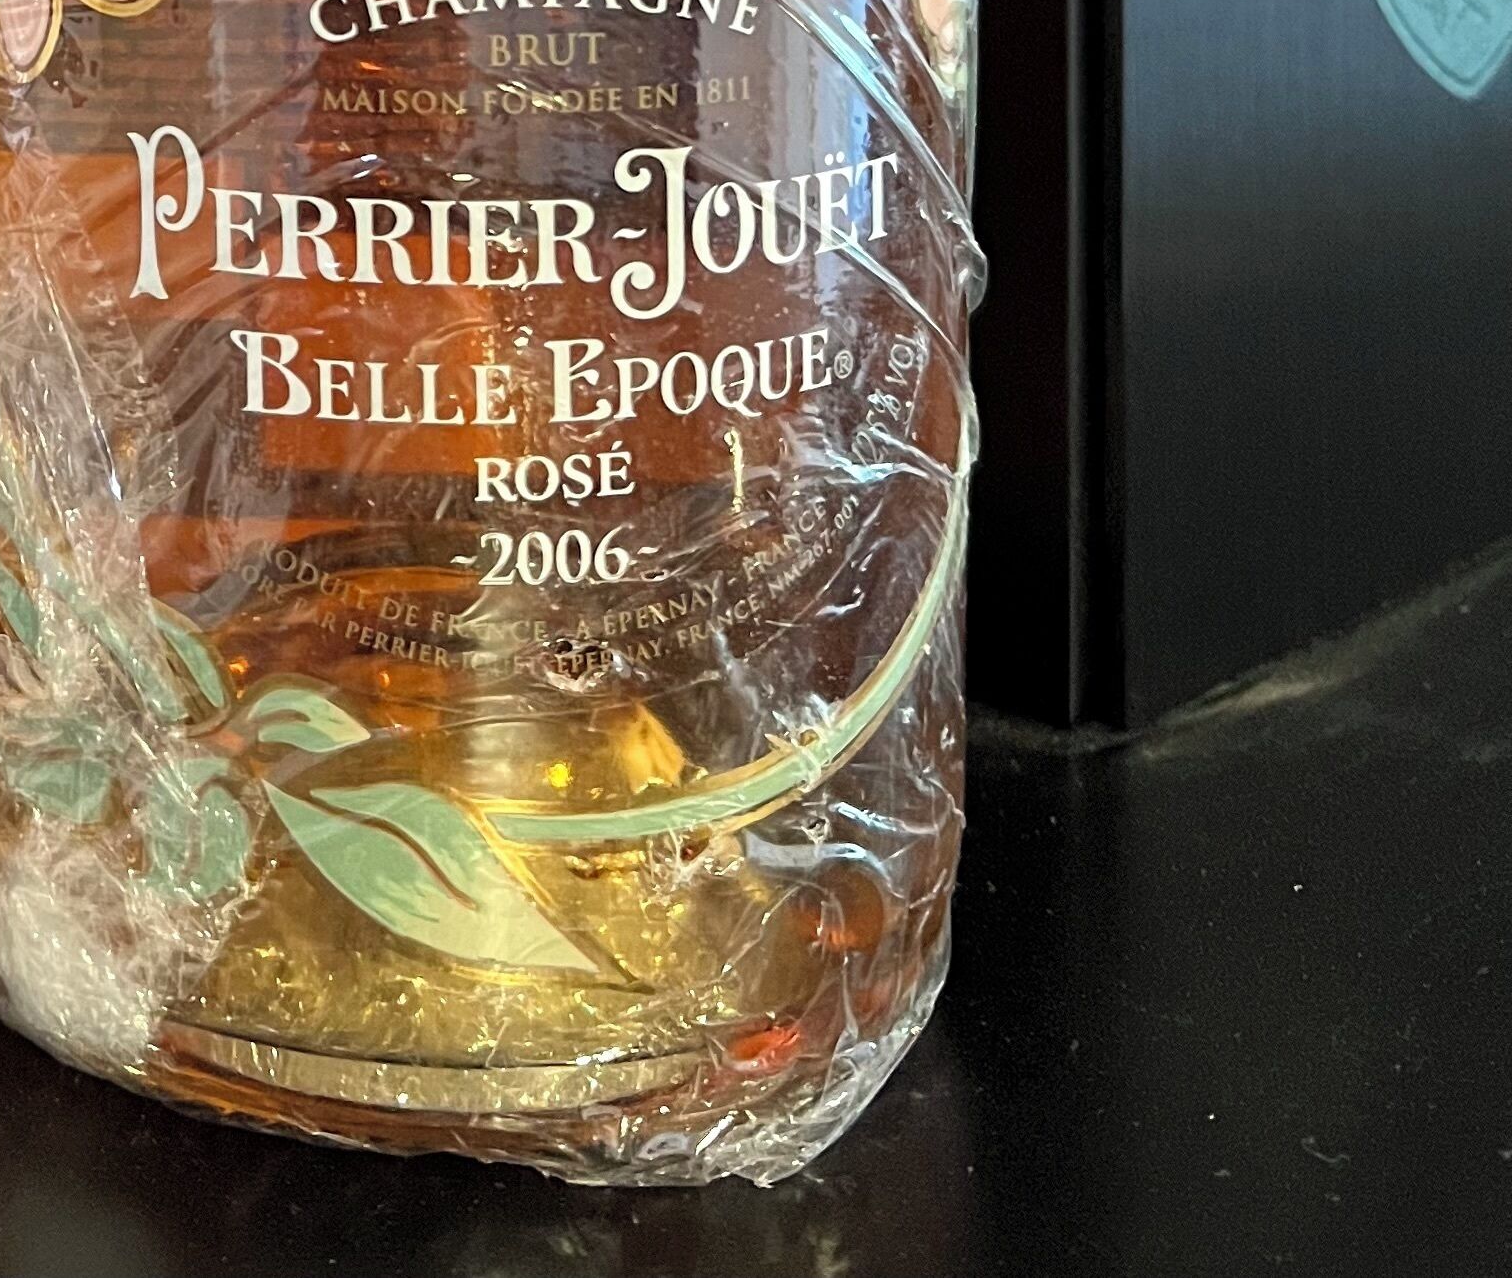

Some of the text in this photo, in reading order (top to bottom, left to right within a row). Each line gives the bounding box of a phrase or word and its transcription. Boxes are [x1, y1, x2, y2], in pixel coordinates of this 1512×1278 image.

[490, 31, 607, 68] BRUT
[322, 75, 752, 116] MAISON FONDÉE EN 1811
[126, 124, 899, 322] PERRIER-JOUËT
[229, 327, 517, 426] BELLE
[473, 439, 636, 504] ROSÉ
[378, 596, 420, 628] DE
